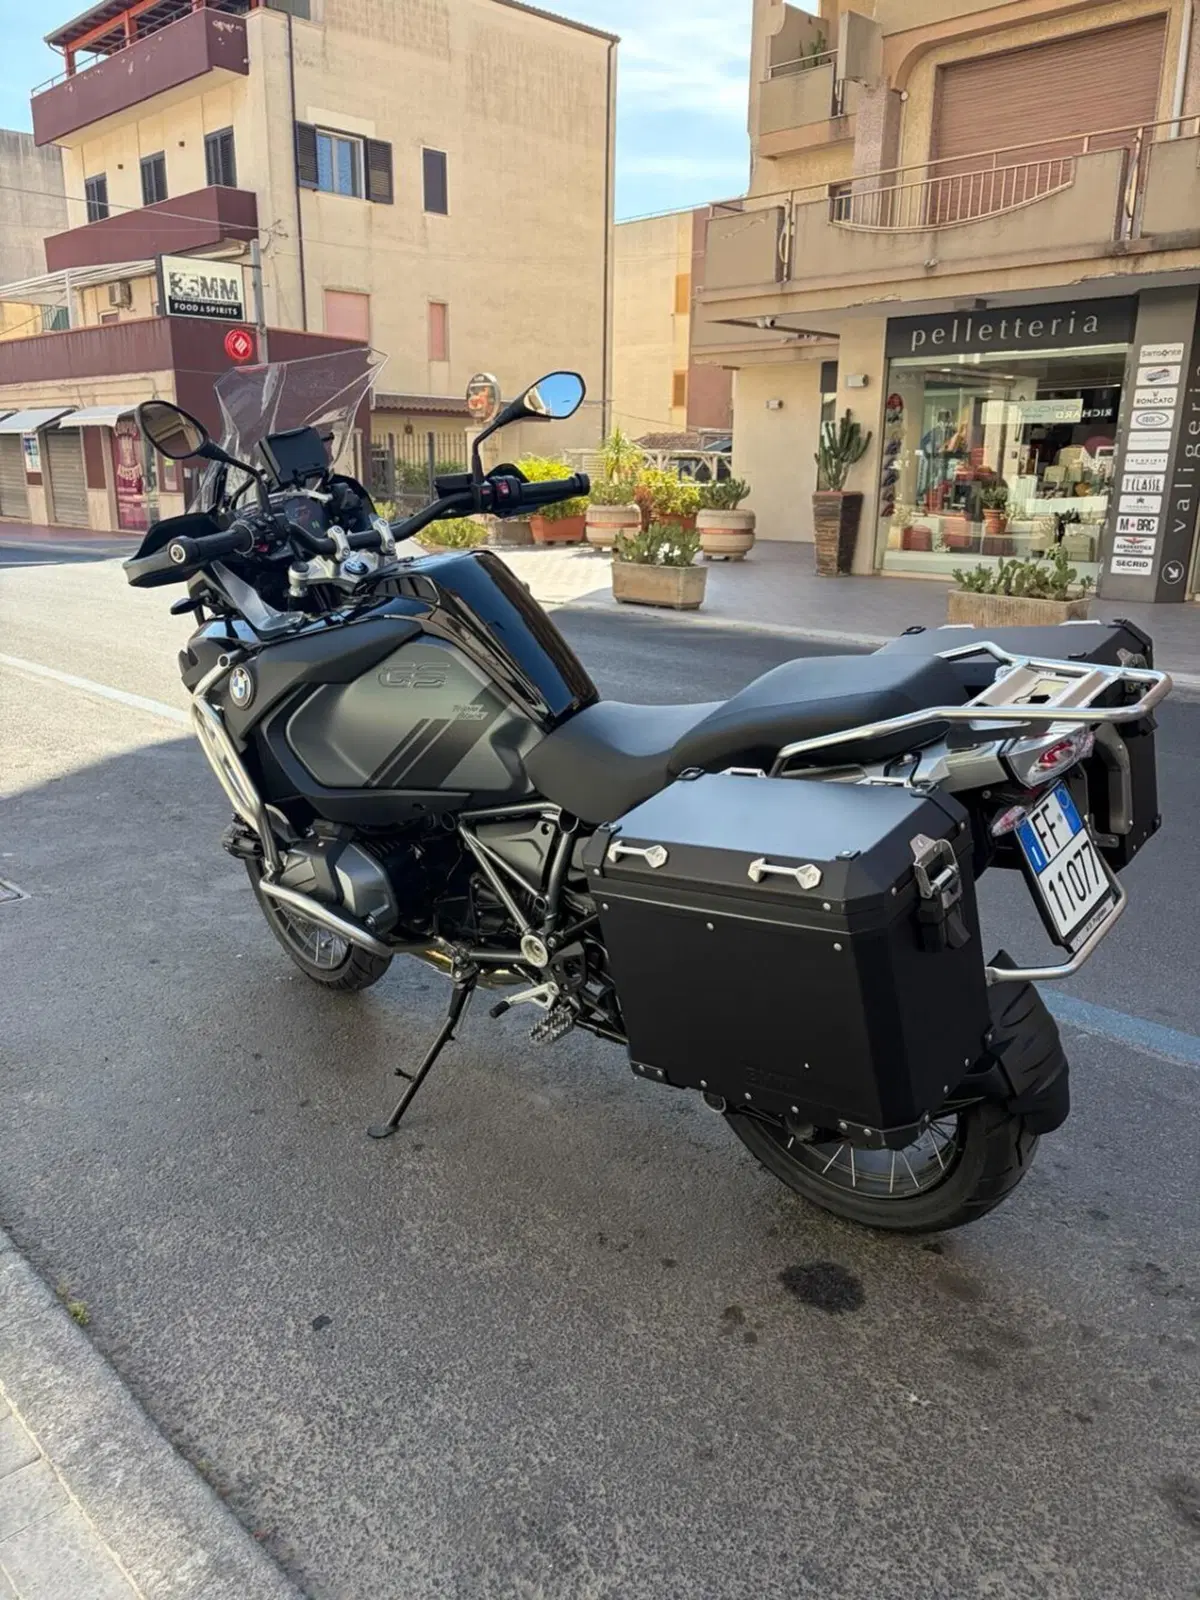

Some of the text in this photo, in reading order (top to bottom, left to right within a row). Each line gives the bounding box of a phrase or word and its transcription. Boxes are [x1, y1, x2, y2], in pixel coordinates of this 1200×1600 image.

[169, 271, 239, 301] 35MM
[174, 302, 198, 311] FOOD
[206, 305, 238, 315] SPIRITS
[911, 310, 1098, 351] pelletteria
[1116, 560, 1148, 568] SECRID
[1032, 804, 1061, 858] FF
[1048, 841, 1099, 921] 11077
